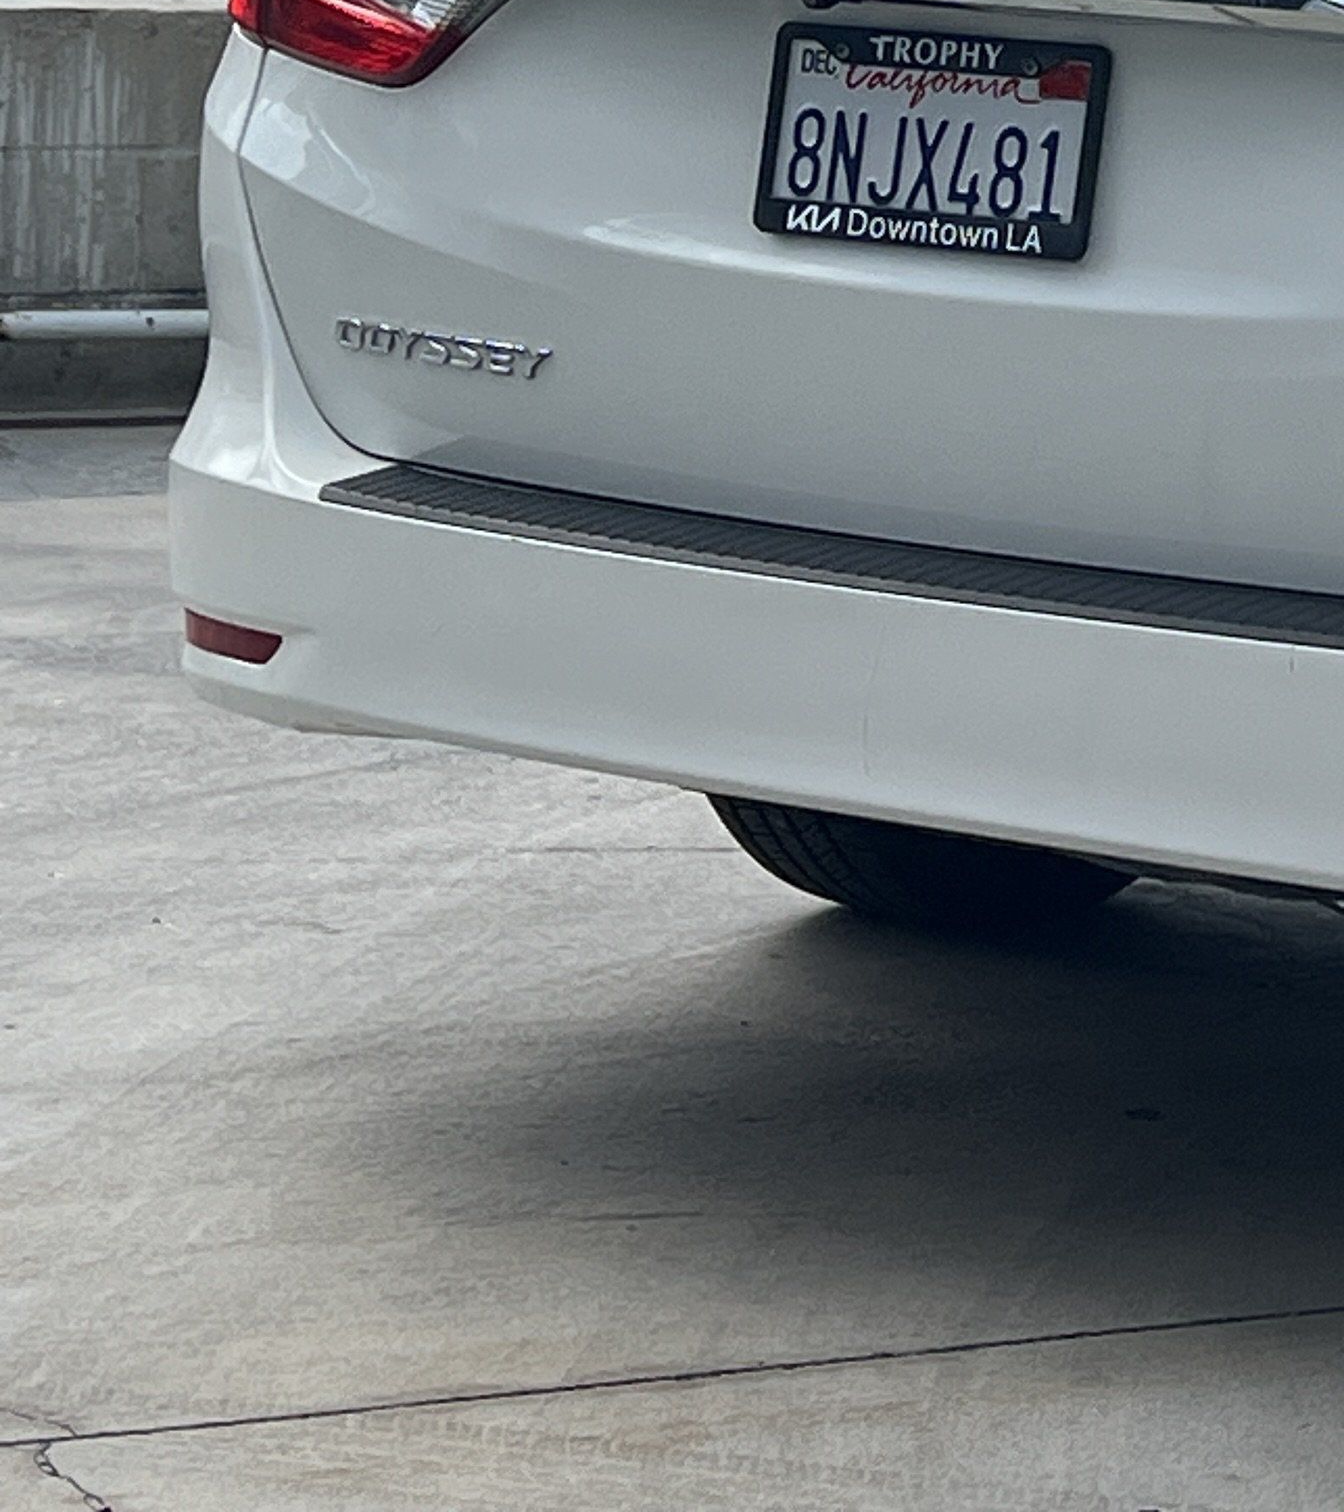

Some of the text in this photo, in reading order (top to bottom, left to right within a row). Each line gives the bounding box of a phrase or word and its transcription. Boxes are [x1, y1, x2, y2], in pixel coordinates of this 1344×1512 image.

[801, 47, 838, 75] DEC
[870, 35, 1004, 70] TROPHY
[787, 108, 1061, 223] 8NJX481
[847, 206, 998, 250] Downtown
[1005, 226, 1042, 254] LA
[336, 316, 553, 379] ODYSSEY
